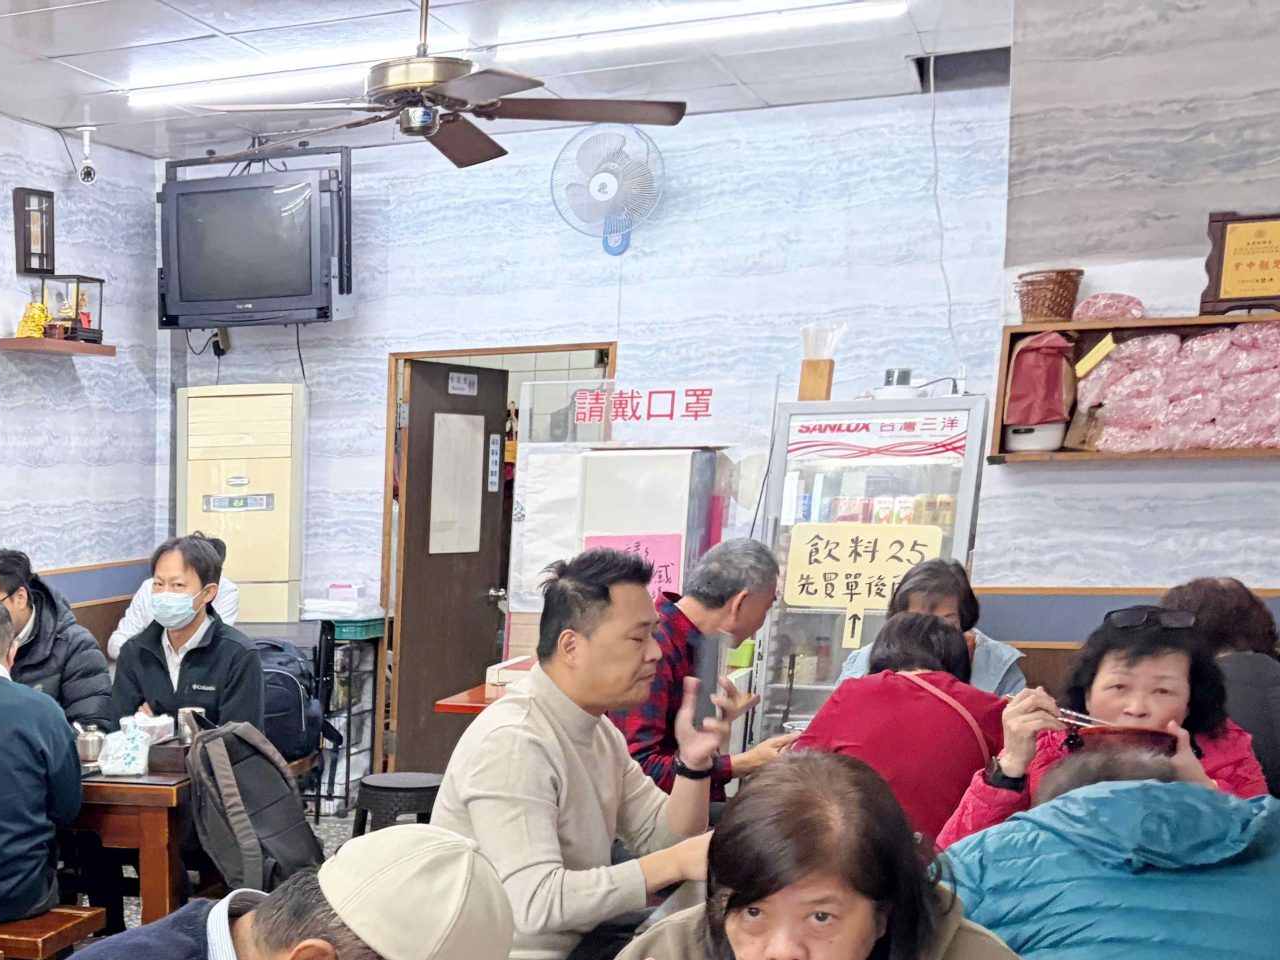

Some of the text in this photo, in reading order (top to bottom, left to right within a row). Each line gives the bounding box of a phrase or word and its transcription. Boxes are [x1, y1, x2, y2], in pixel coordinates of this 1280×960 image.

[575, 388, 713, 423] 請戴口罩
[798, 421, 871, 434] SANLUX
